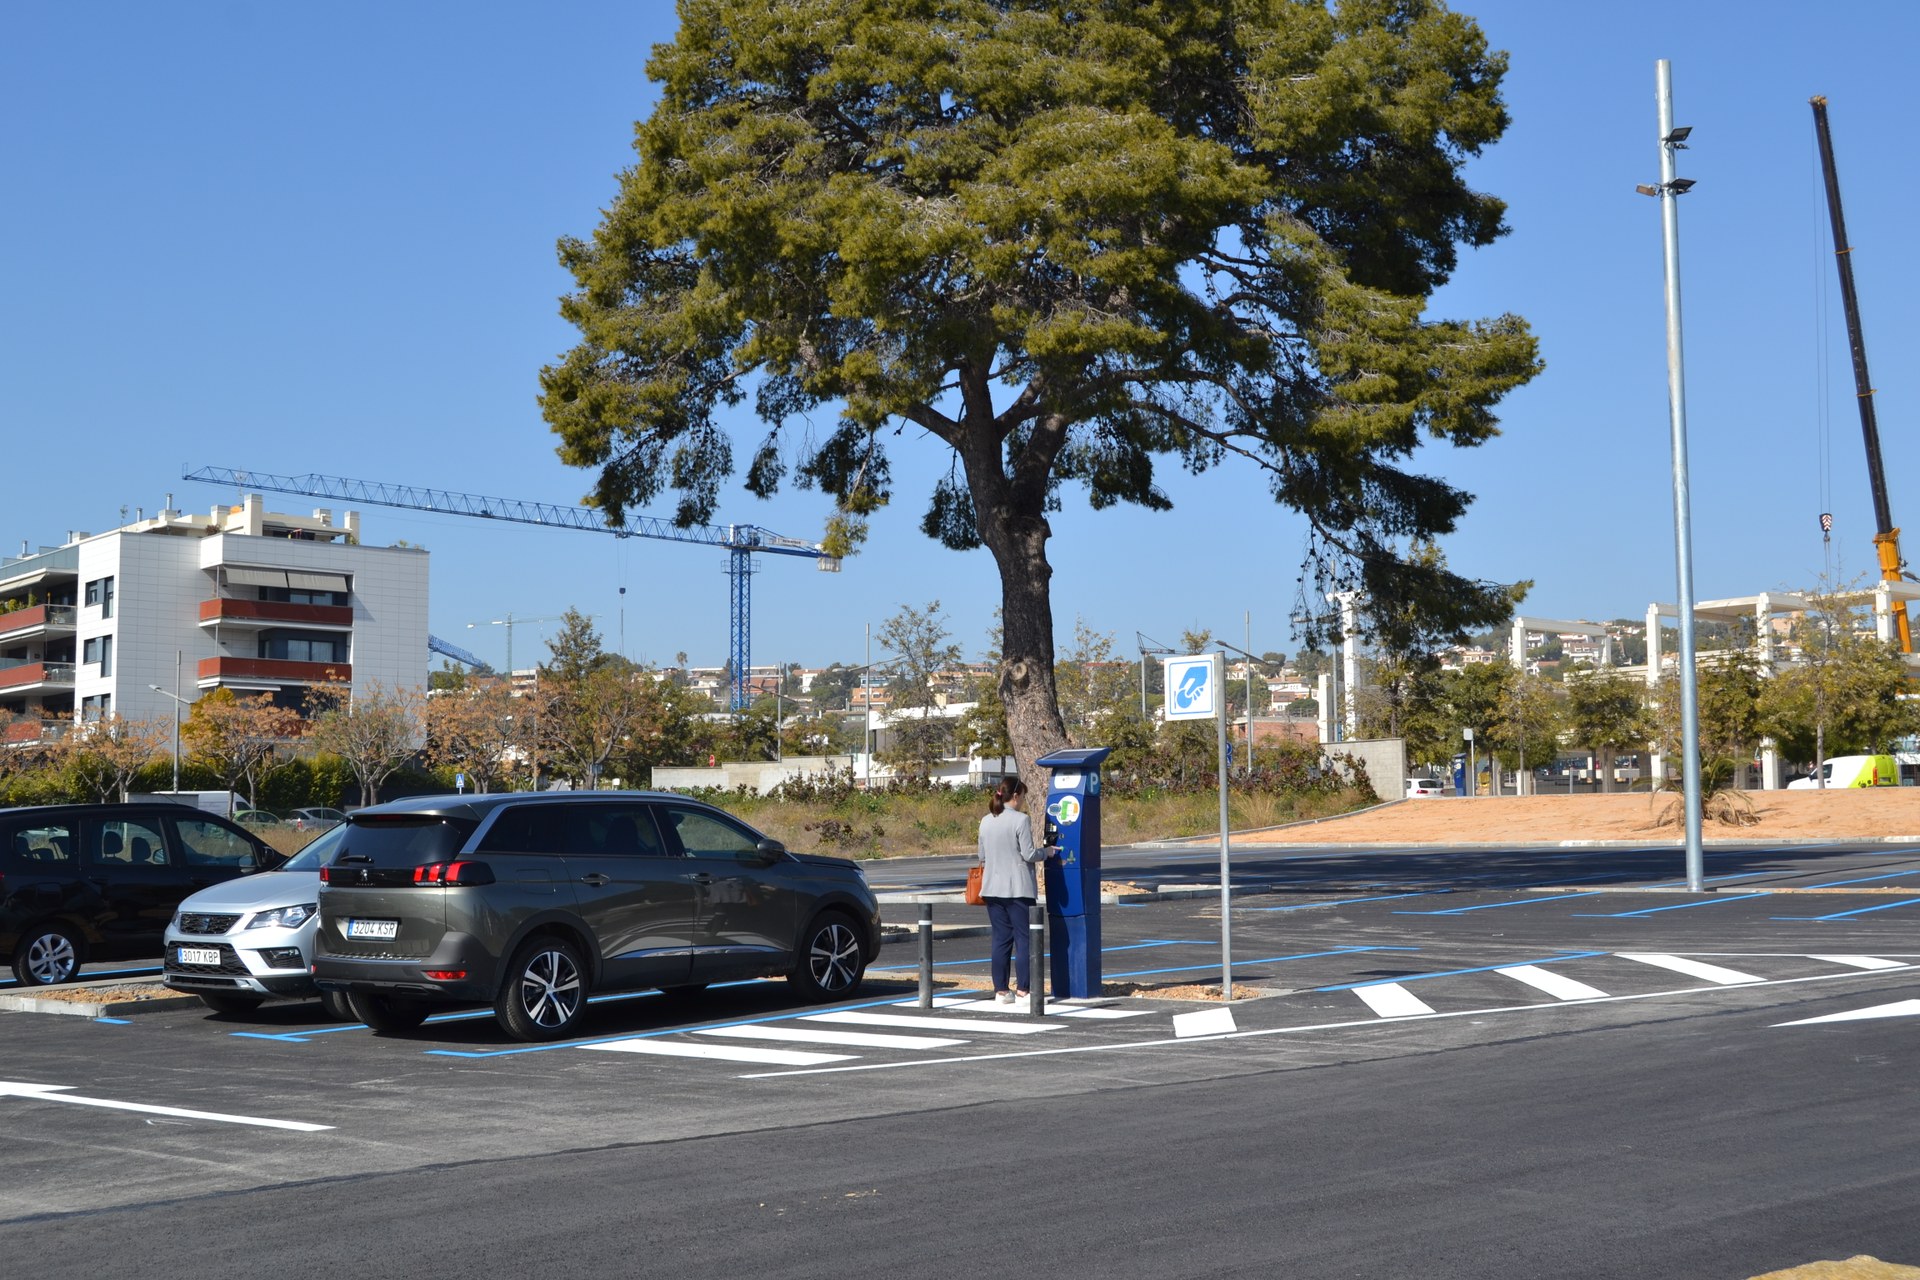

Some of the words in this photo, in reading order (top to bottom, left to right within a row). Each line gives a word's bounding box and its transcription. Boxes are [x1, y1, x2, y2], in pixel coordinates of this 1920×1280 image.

[1090, 771, 1099, 793] P
[354, 921, 375, 935] 3204
[377, 922, 395, 935] KSR
[183, 950, 201, 962] 3017
[203, 951, 219, 963] KBP
